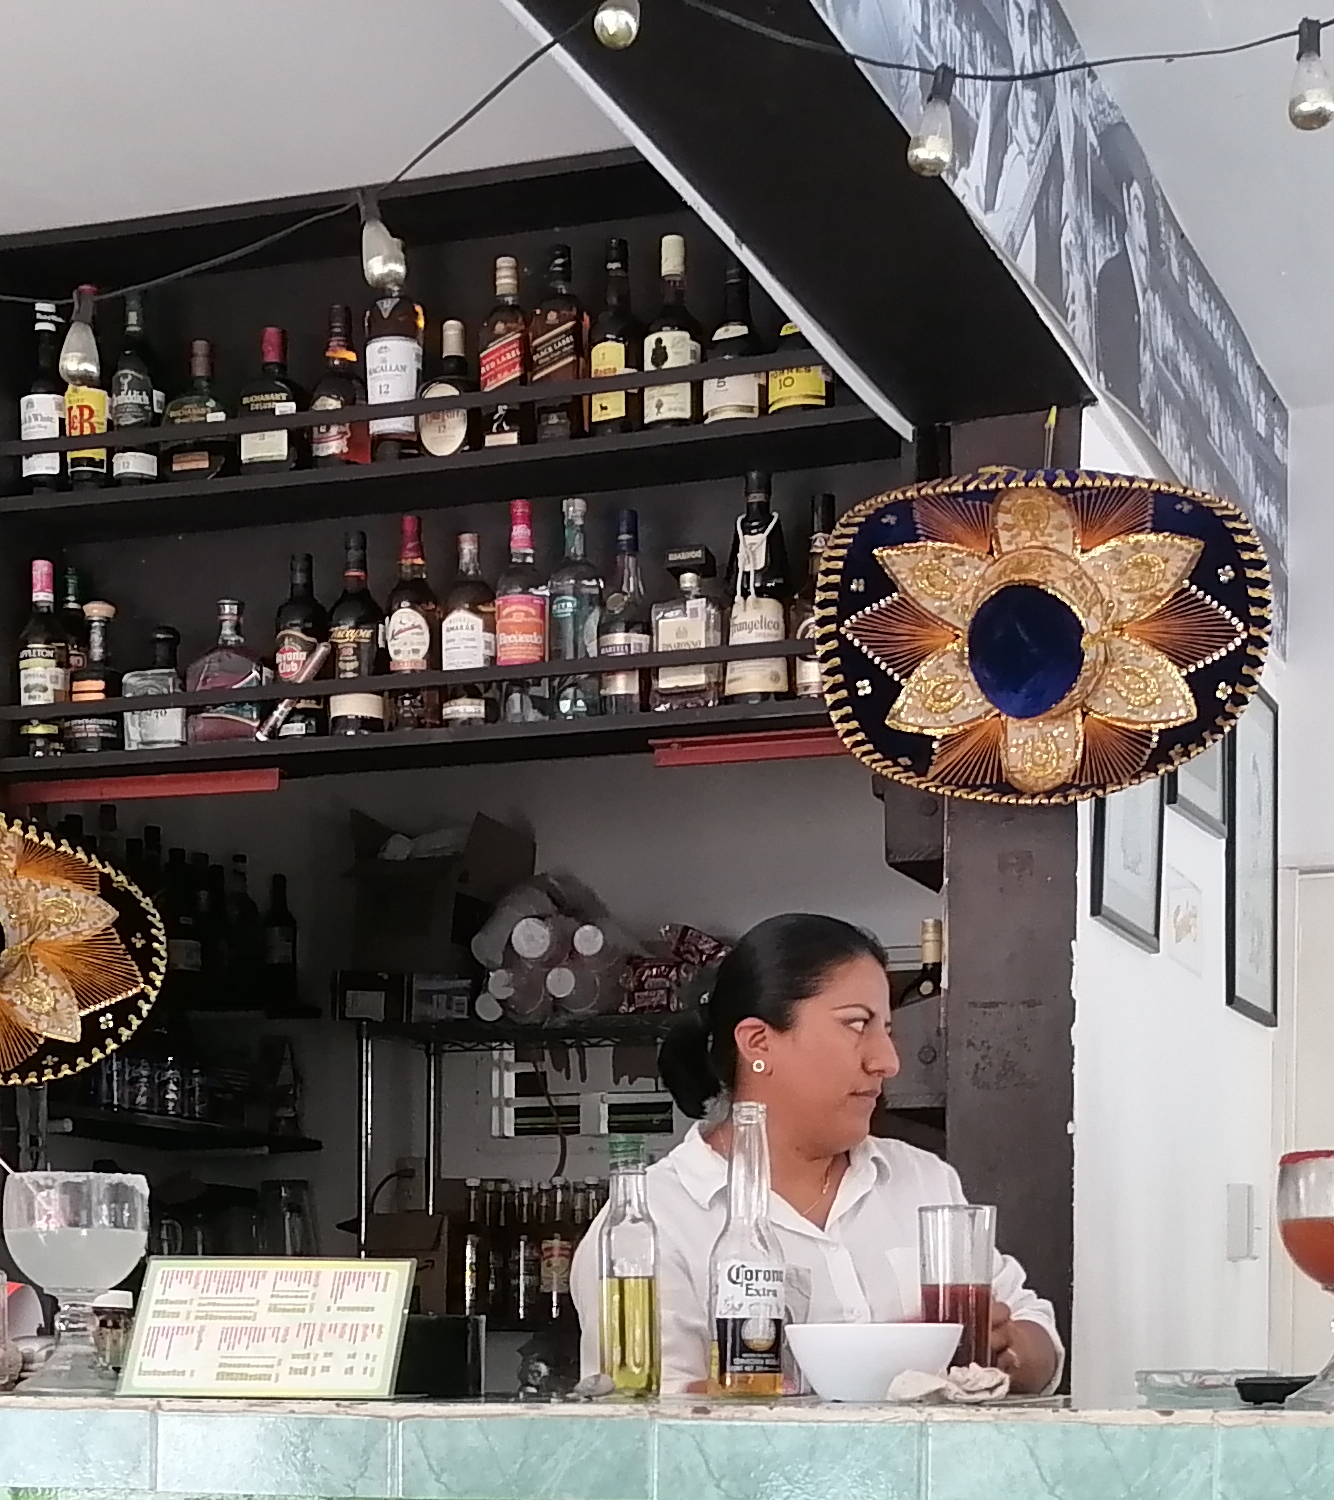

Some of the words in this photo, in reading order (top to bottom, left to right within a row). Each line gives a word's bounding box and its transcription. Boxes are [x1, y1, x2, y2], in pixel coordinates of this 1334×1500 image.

[554, 335, 574, 350] LABEL
[481, 361, 496, 374] RED
[497, 349, 521, 364] LABEL
[778, 376, 794, 390] 10
[379, 386, 390, 396] 12
[498, 631, 543, 644] Recuerdo
[279, 660, 298, 673] Club
[745, 1284, 778, 1297] Extra
